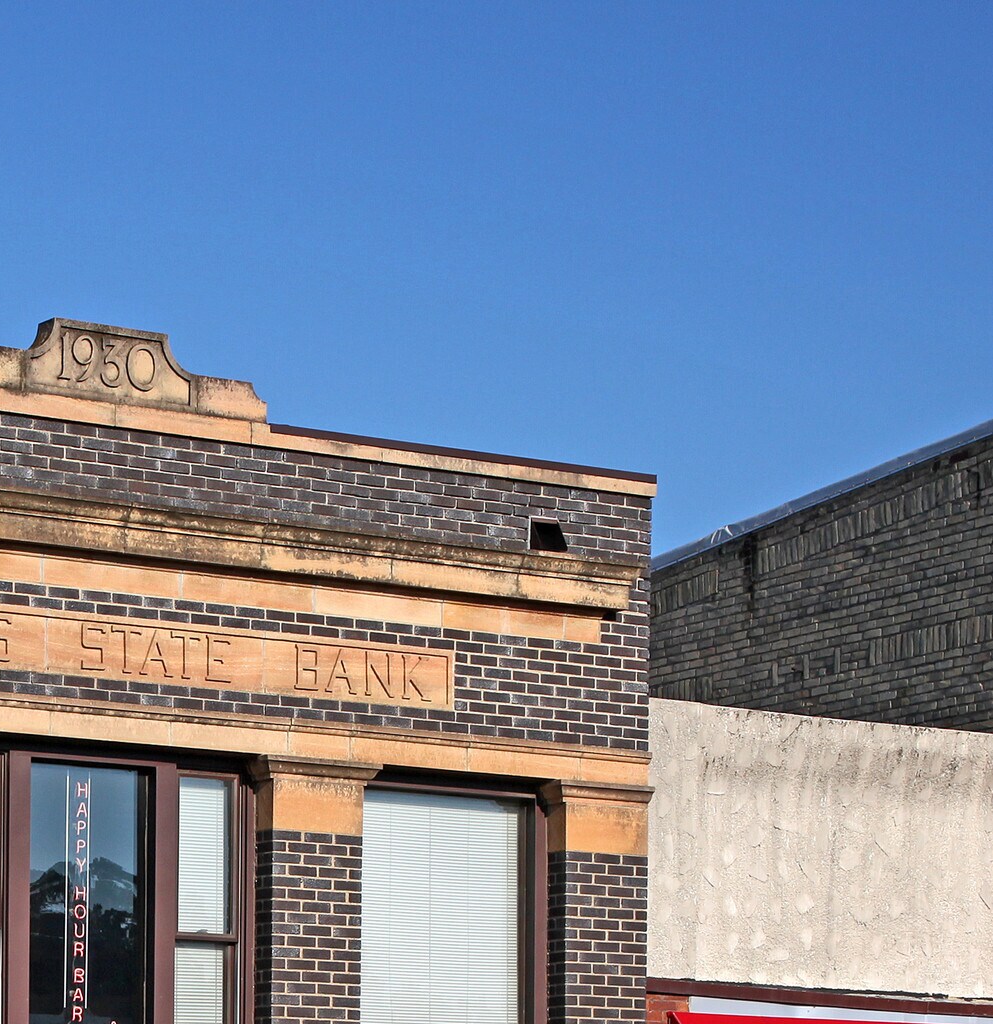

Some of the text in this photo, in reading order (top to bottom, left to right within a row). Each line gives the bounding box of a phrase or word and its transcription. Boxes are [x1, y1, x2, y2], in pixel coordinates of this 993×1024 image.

[58, 331, 156, 393] 1930
[80, 622, 232, 684] STATE
[293, 644, 433, 703] BANK
[72, 782, 88, 1022] HAPPY HOUR BAR
